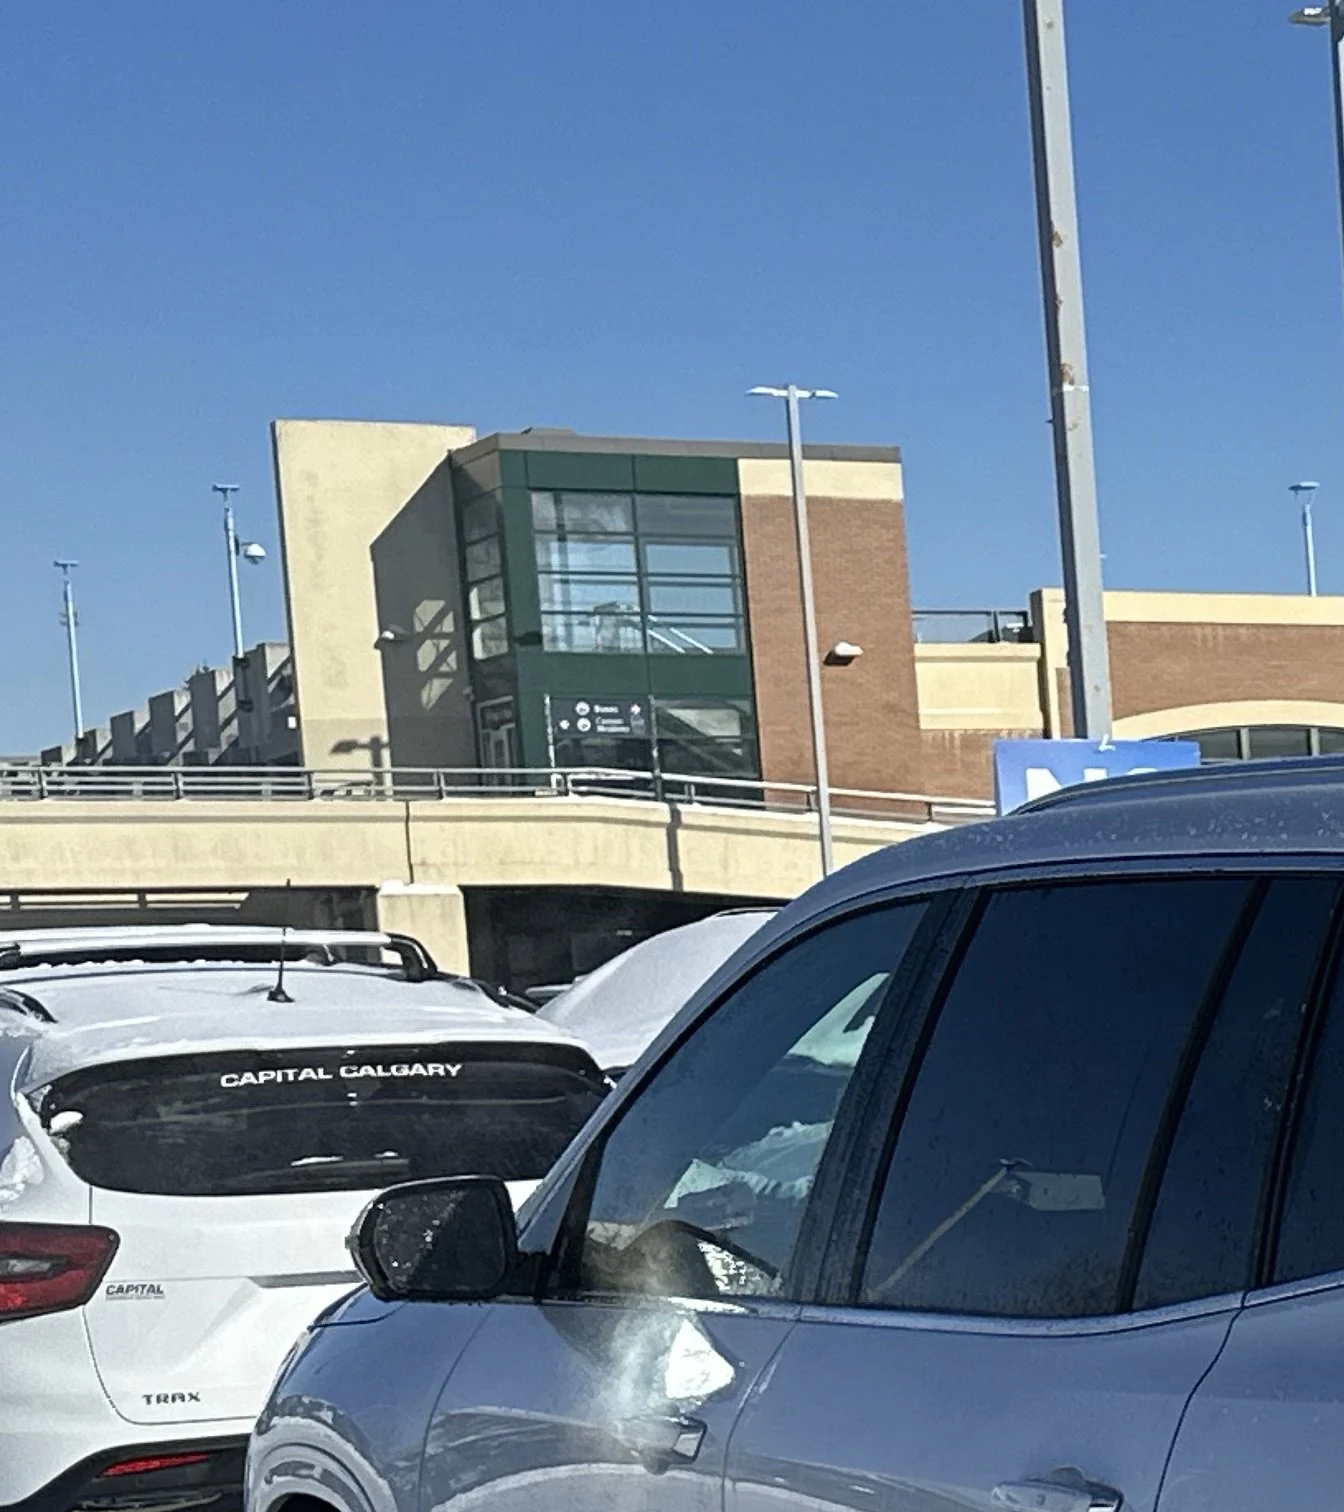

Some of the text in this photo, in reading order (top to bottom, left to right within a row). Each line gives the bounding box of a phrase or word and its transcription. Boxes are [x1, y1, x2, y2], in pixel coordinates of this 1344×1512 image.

[220, 1063, 463, 1088] CAPITAL CALGARY
[105, 1284, 164, 1296] CAPITAL
[142, 1392, 201, 1406] TRAX
